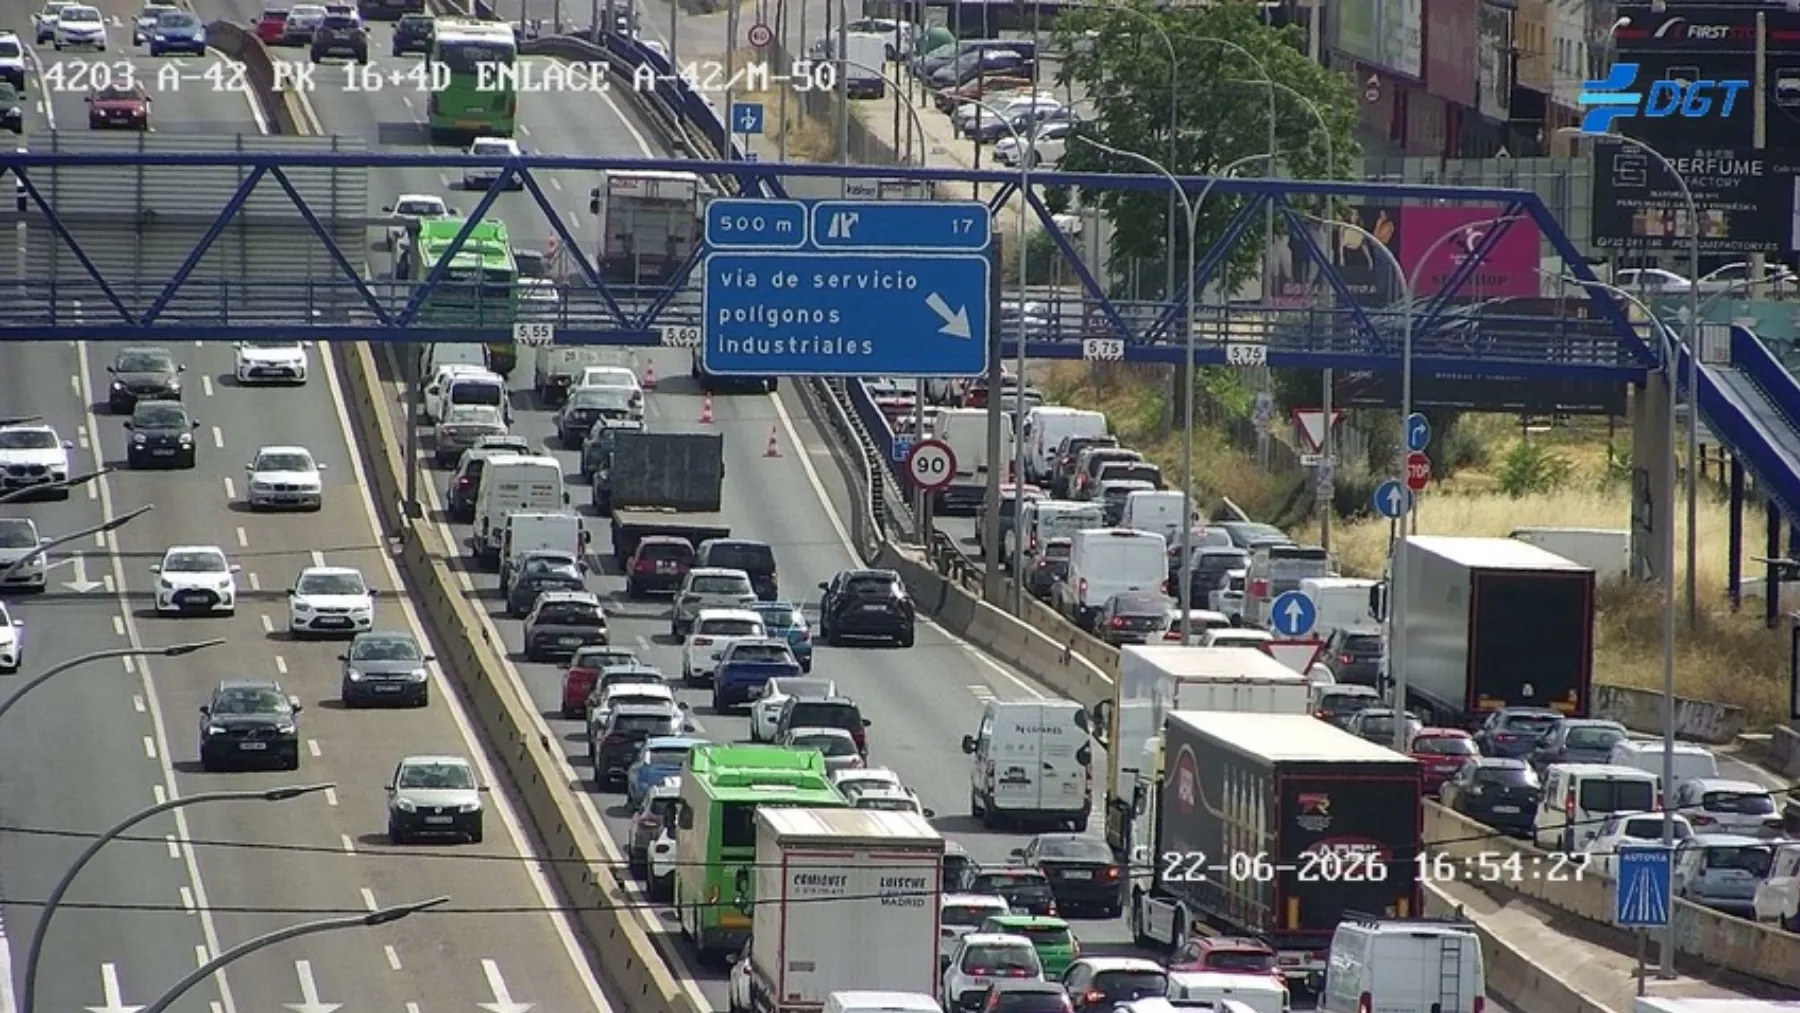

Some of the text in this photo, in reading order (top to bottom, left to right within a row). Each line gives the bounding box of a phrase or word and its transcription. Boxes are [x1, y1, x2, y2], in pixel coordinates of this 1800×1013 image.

[1663, 158, 1764, 177] PERFUME
[1685, 176, 1742, 189] FACTORY
[719, 215, 792, 233] 500 m
[951, 218, 974, 235] 17
[771, 270, 799, 289] de
[813, 270, 918, 290] servicio
[719, 304, 841, 328] polígonos
[719, 335, 874, 355] industriales
[917, 456, 945, 474] 90
[880, 898, 926, 909] MADRID
